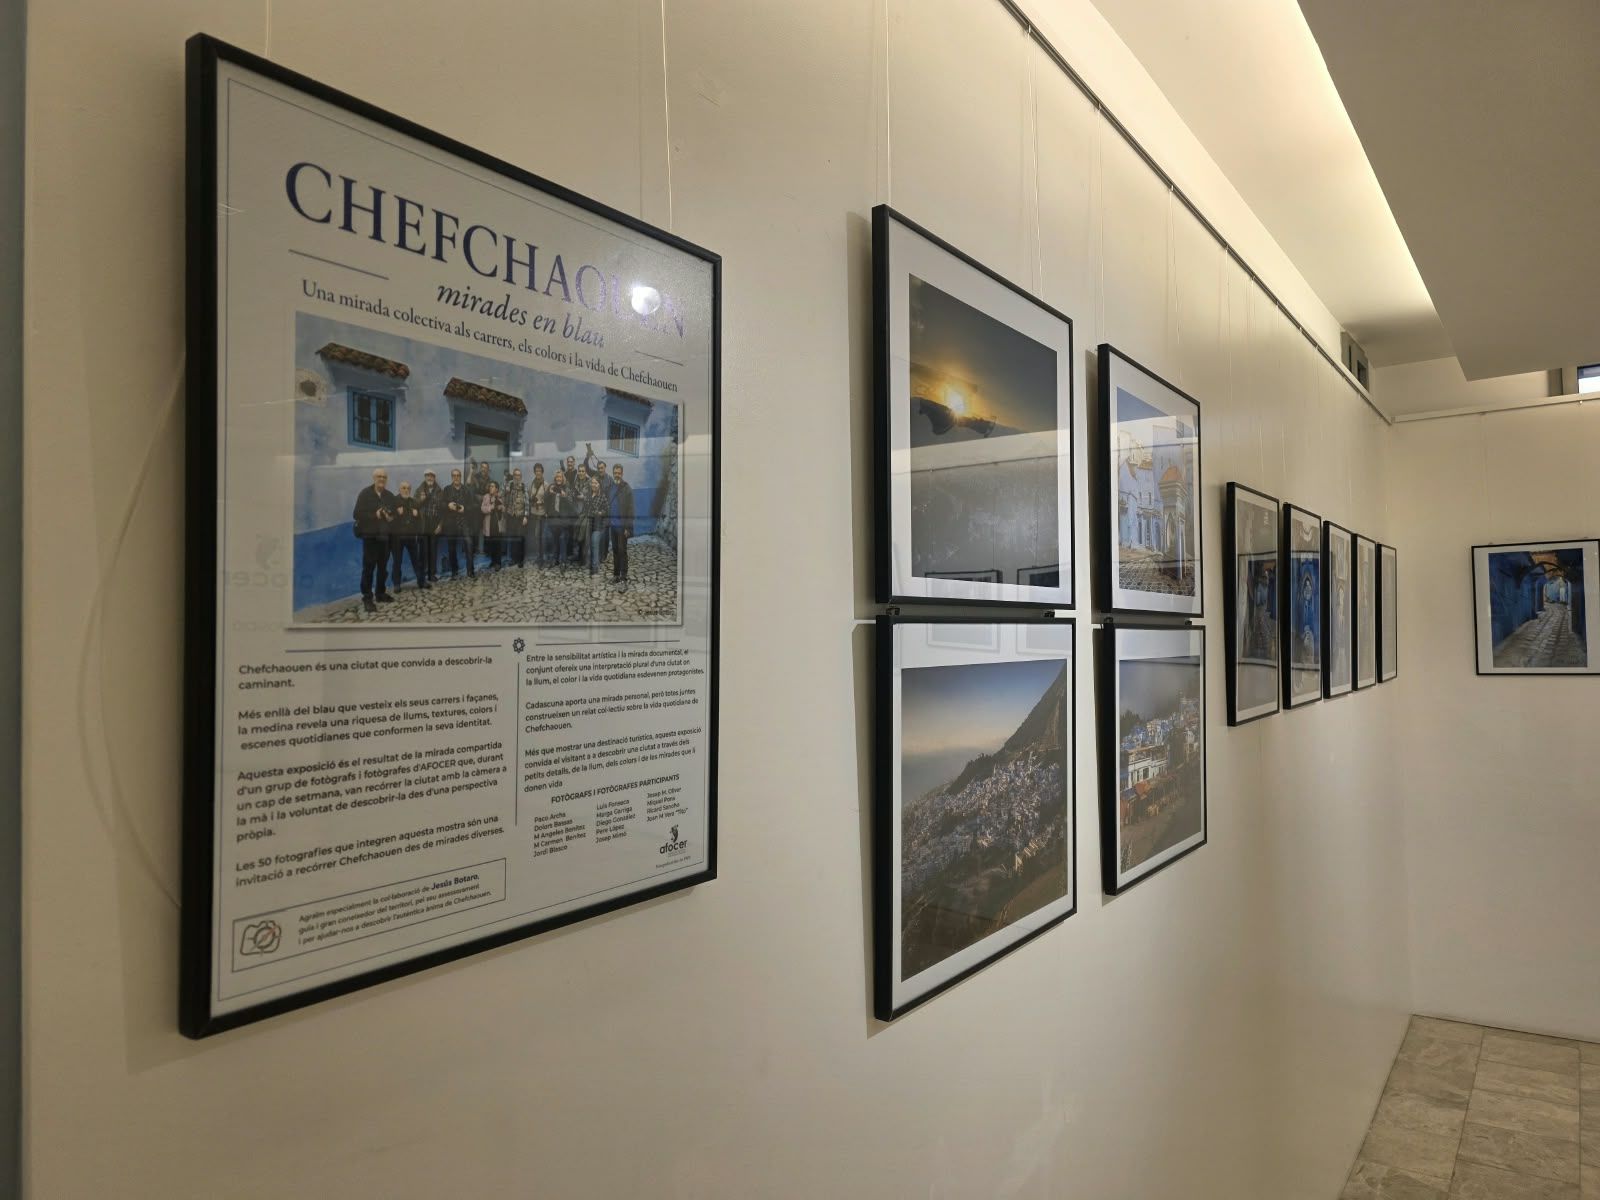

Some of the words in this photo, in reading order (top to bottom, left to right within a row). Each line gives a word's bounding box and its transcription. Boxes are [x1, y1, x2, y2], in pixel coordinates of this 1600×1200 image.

[285, 162, 685, 339] CHEFCHAOUN
[437, 285, 527, 325] mirades
[533, 315, 555, 333] en
[562, 321, 605, 347] blau
[302, 279, 334, 302] Una
[339, 295, 389, 317] mirada
[393, 308, 451, 332] colectiva
[454, 322, 470, 337] als
[473, 331, 515, 350] carrers,
[518, 338, 532, 353] els
[534, 345, 566, 362] colors
[574, 352, 582, 367] la
[585, 358, 605, 373] vida
[607, 362, 618, 376] de
[620, 366, 677, 392] Chefchaouen
[238, 664, 312, 674] Chefchaouen
[314, 662, 327, 671] és
[350, 660, 378, 669] ciutat
[380, 661, 399, 669] que
[400, 658, 435, 667] convida
[444, 656, 492, 665] descobrir-la
[525, 665, 553, 674] conjunt
[554, 664, 577, 672] ofereix
[592, 661, 631, 670] interpretació
[238, 678, 294, 689] caminant.
[525, 700, 564, 709] Cadascuna
[565, 698, 586, 706] aporta
[601, 694, 623, 702] mirada
[624, 691, 650, 701] personal,
[651, 690, 664, 698] però
[679, 688, 695, 696] juntes
[238, 710, 261, 719] Més
[264, 707, 290, 717] enllà
[293, 706, 310, 715] del
[312, 704, 335, 713] blau
[337, 704, 356, 713] que
[359, 700, 392, 709] vesteix
[394, 699, 407, 707] els
[431, 696, 460, 704] carrers
[466, 694, 498, 703] façanes,
[238, 725, 247, 734] la
[250, 722, 293, 733] medina
[296, 719, 327, 729] revela
[351, 715, 387, 725] riquesa
[389, 713, 401, 721] de
[431, 709, 467, 717] textures,
[469, 706, 493, 714] colors
[240, 739, 286, 749] escenes
[288, 732, 350, 746] quotidianes
[352, 730, 371, 740] que
[373, 725, 423, 736] conformen
[425, 723, 433, 731] la
[435, 722, 454, 730] seva
[455, 718, 492, 727] identitat.
[524, 722, 572, 732] Chefchaouen.
[524, 748, 539, 756] Més
[540, 747, 554, 755] que
[555, 743, 582, 752] mostrar
[596, 736, 628, 746] destinació
[629, 733, 654, 742] turística,
[677, 726, 701, 735] exposició
[236, 786, 262, 795] d'un
[265, 782, 292, 793] grup
[294, 778, 307, 787] de
[310, 772, 356, 785] fotògrafs
[364, 765, 411, 778] fotògrafes
[412, 759, 456, 771] d'AFOCER
[457, 758, 475, 766] que,
[477, 753, 503, 763] durant
[237, 768, 284, 780] Aquesta
[286, 760, 336, 774] exposició
[351, 757, 360, 766] el
[362, 753, 399, 764] resultat
[400, 752, 412, 760] de
[424, 746, 454, 757] mirada
[456, 741, 502, 753] compartida
[236, 802, 252, 810] un
[255, 799, 275, 808] cap
[278, 795, 292, 804] de
[294, 790, 342, 802] setmana,
[344, 786, 362, 794] van
[364, 781, 401, 791] recórrer
[404, 778, 412, 786] la
[414, 775, 439, 784] ciutat
[441, 771, 460, 780] amb
[471, 766, 500, 776] càmera
[523, 783, 547, 792] donen
[548, 780, 562, 788] vida
[551, 790, 592, 803] FOTÒGRAFS
[596, 781, 638, 794] FOTÒGRAFES
[639, 773, 679, 786] PARTICIPANTS
[236, 817, 246, 825] la
[249, 813, 267, 823] mà
[276, 811, 286, 819] la
[289, 804, 332, 817] voluntat
[335, 801, 348, 810] de
[350, 792, 406, 808] descobrir-la
[408, 790, 424, 798] des
[425, 787, 449, 796] d'una
[451, 779, 497, 794] perspectiva
[235, 861, 255, 871] Les
[258, 857, 272, 867] 50
[274, 847, 332, 863] fotografies
[334, 843, 354, 853] que
[356, 835, 396, 848] integren
[398, 828, 434, 840] aquesta
[436, 822, 465, 832] mostra
[467, 818, 481, 827] són
[236, 827, 275, 843] pròpia.
[660, 840, 687, 854] afocer
[235, 869, 284, 886] invitació
[295, 860, 336, 874] recórrer
[339, 847, 402, 865] Chefchaouen
[404, 843, 420, 852] des
[422, 840, 433, 848] de
[435, 834, 469, 845] mirades
[470, 827, 504, 838] diverses.
